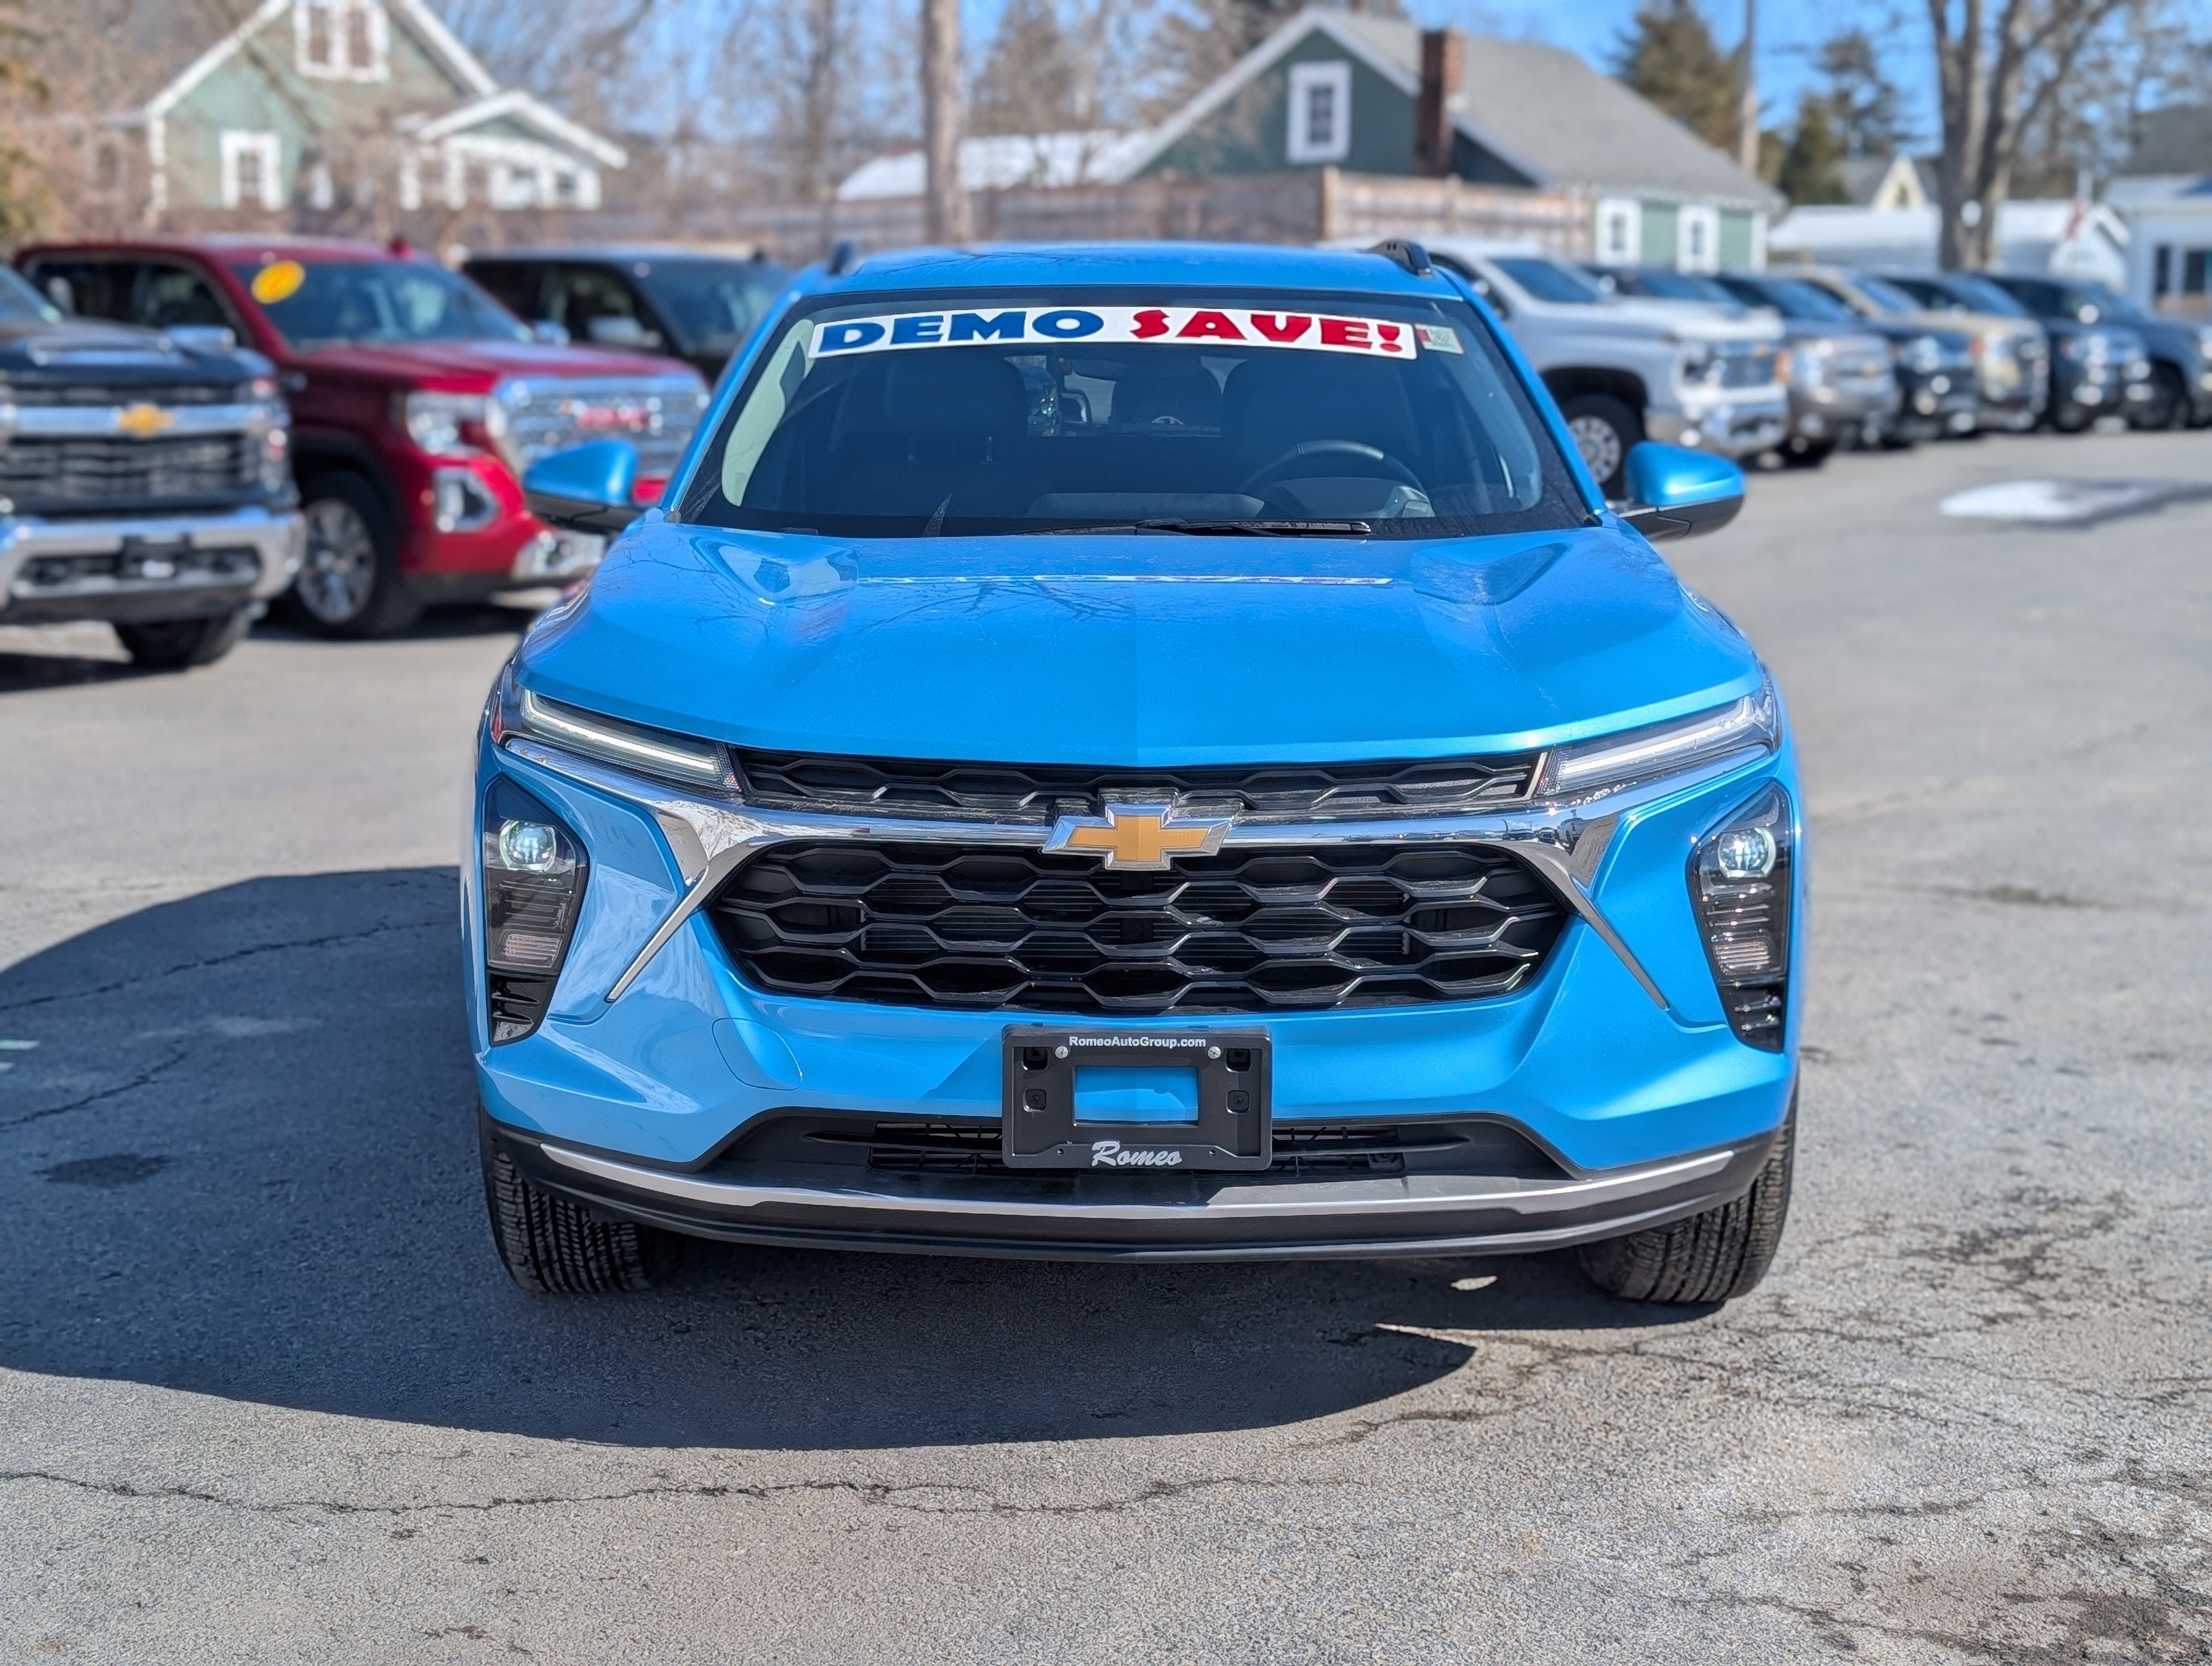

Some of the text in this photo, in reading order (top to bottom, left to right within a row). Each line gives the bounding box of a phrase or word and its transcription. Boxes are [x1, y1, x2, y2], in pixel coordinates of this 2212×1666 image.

[818, 310, 1104, 353] DEMO
[1130, 309, 1403, 353] SAVE!
[1069, 1036, 1206, 1049] RomeoAutoGroup.com
[1091, 1140, 1183, 1167] Romeo
